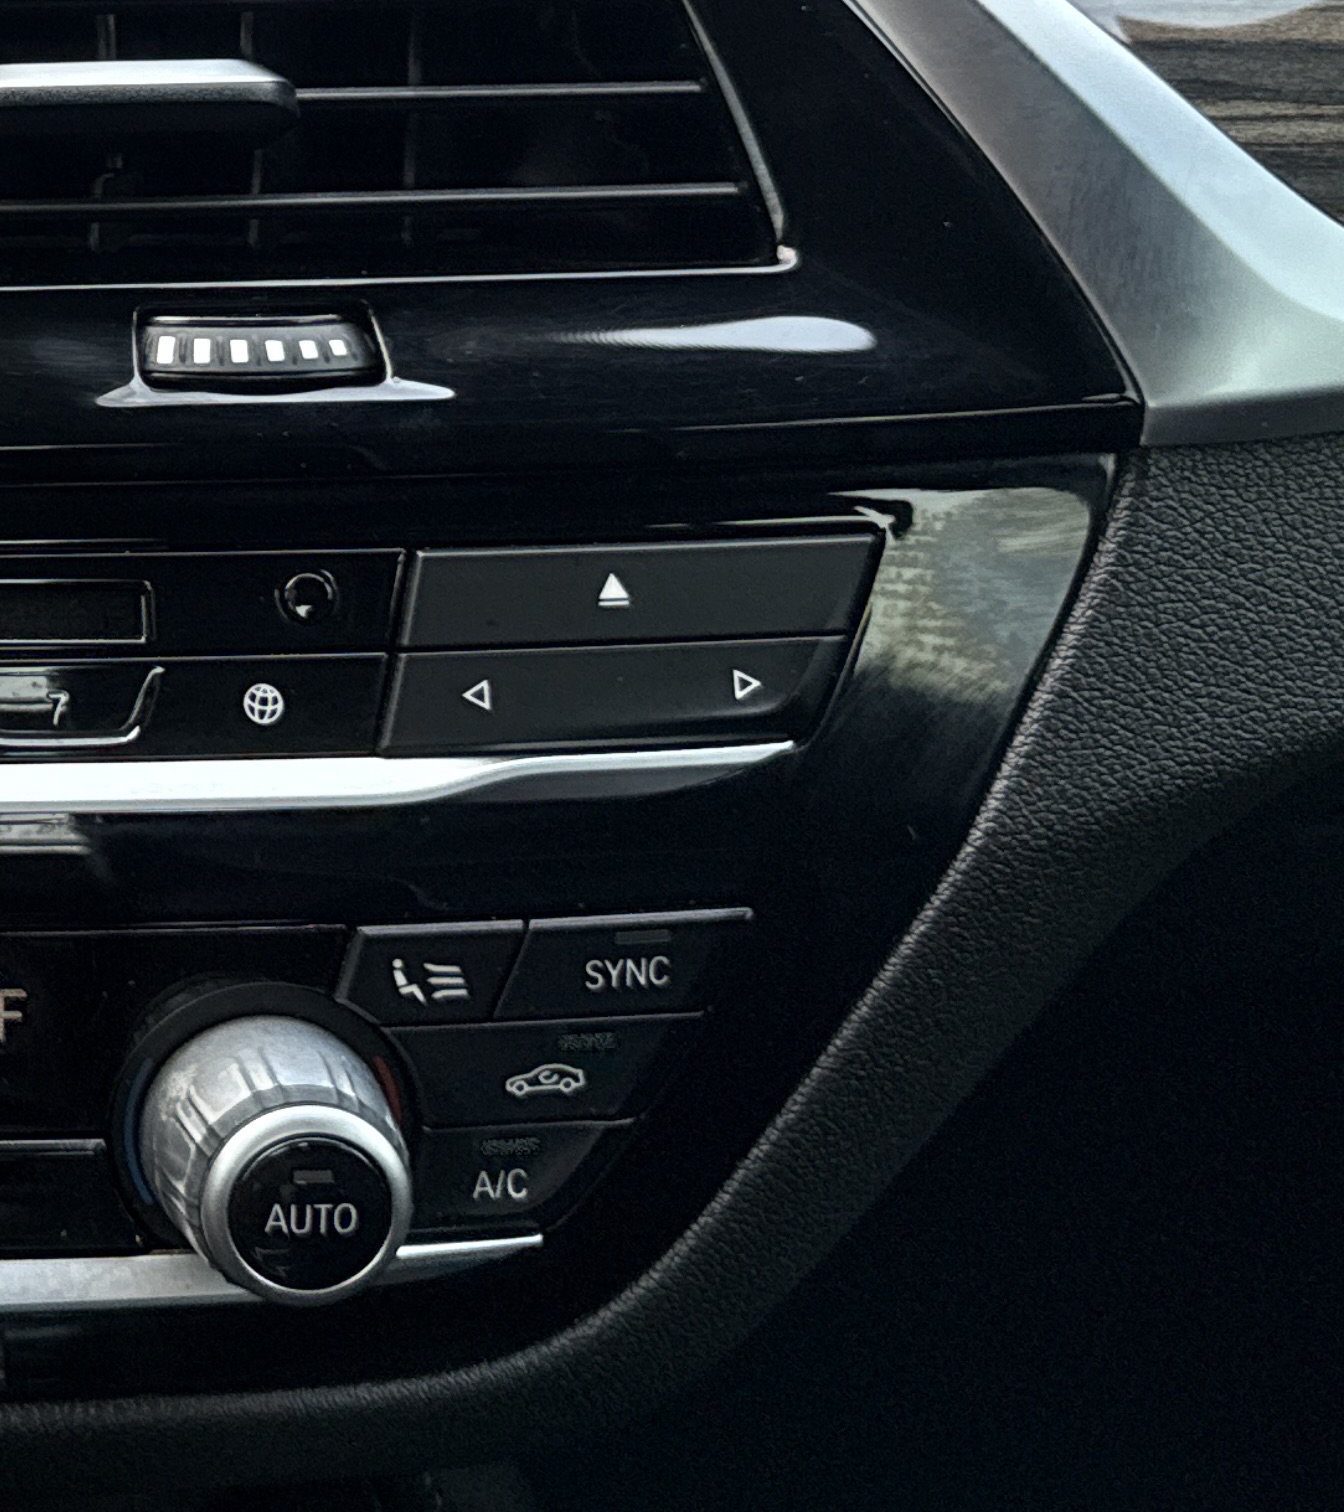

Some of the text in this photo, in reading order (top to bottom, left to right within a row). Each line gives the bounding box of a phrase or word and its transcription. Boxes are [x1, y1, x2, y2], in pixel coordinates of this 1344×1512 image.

[46, 692, 69, 726] 7
[584, 955, 672, 991] SYNC
[471, 1169, 529, 1201] A/C
[263, 1202, 359, 1236] AUTO
